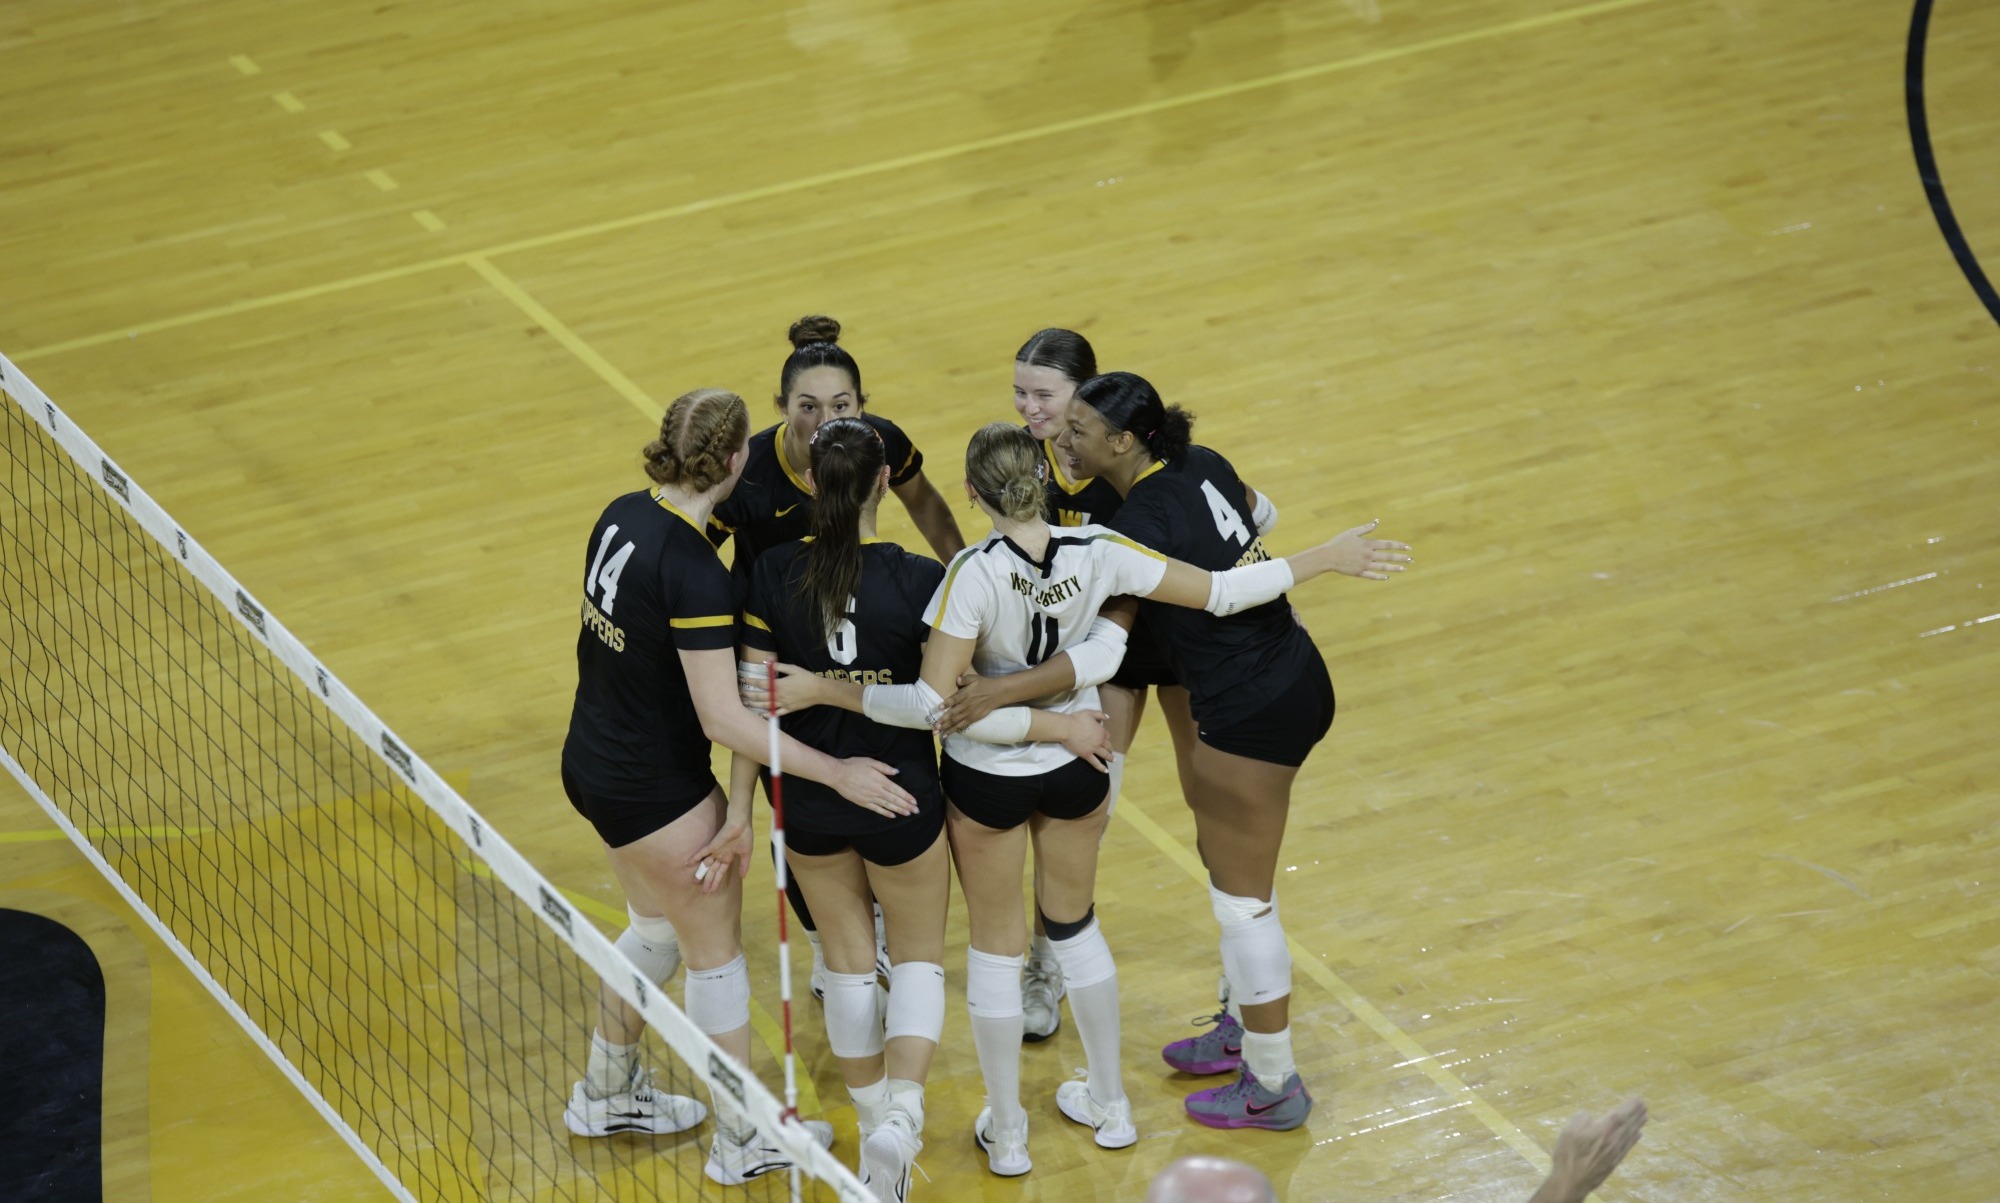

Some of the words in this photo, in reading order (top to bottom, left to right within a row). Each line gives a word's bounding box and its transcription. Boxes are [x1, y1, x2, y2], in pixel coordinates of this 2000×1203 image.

[1201, 479, 1251, 547] 4
[587, 524, 636, 617] 14
[822, 593, 858, 665] 6
[1026, 612, 1060, 666] 11
